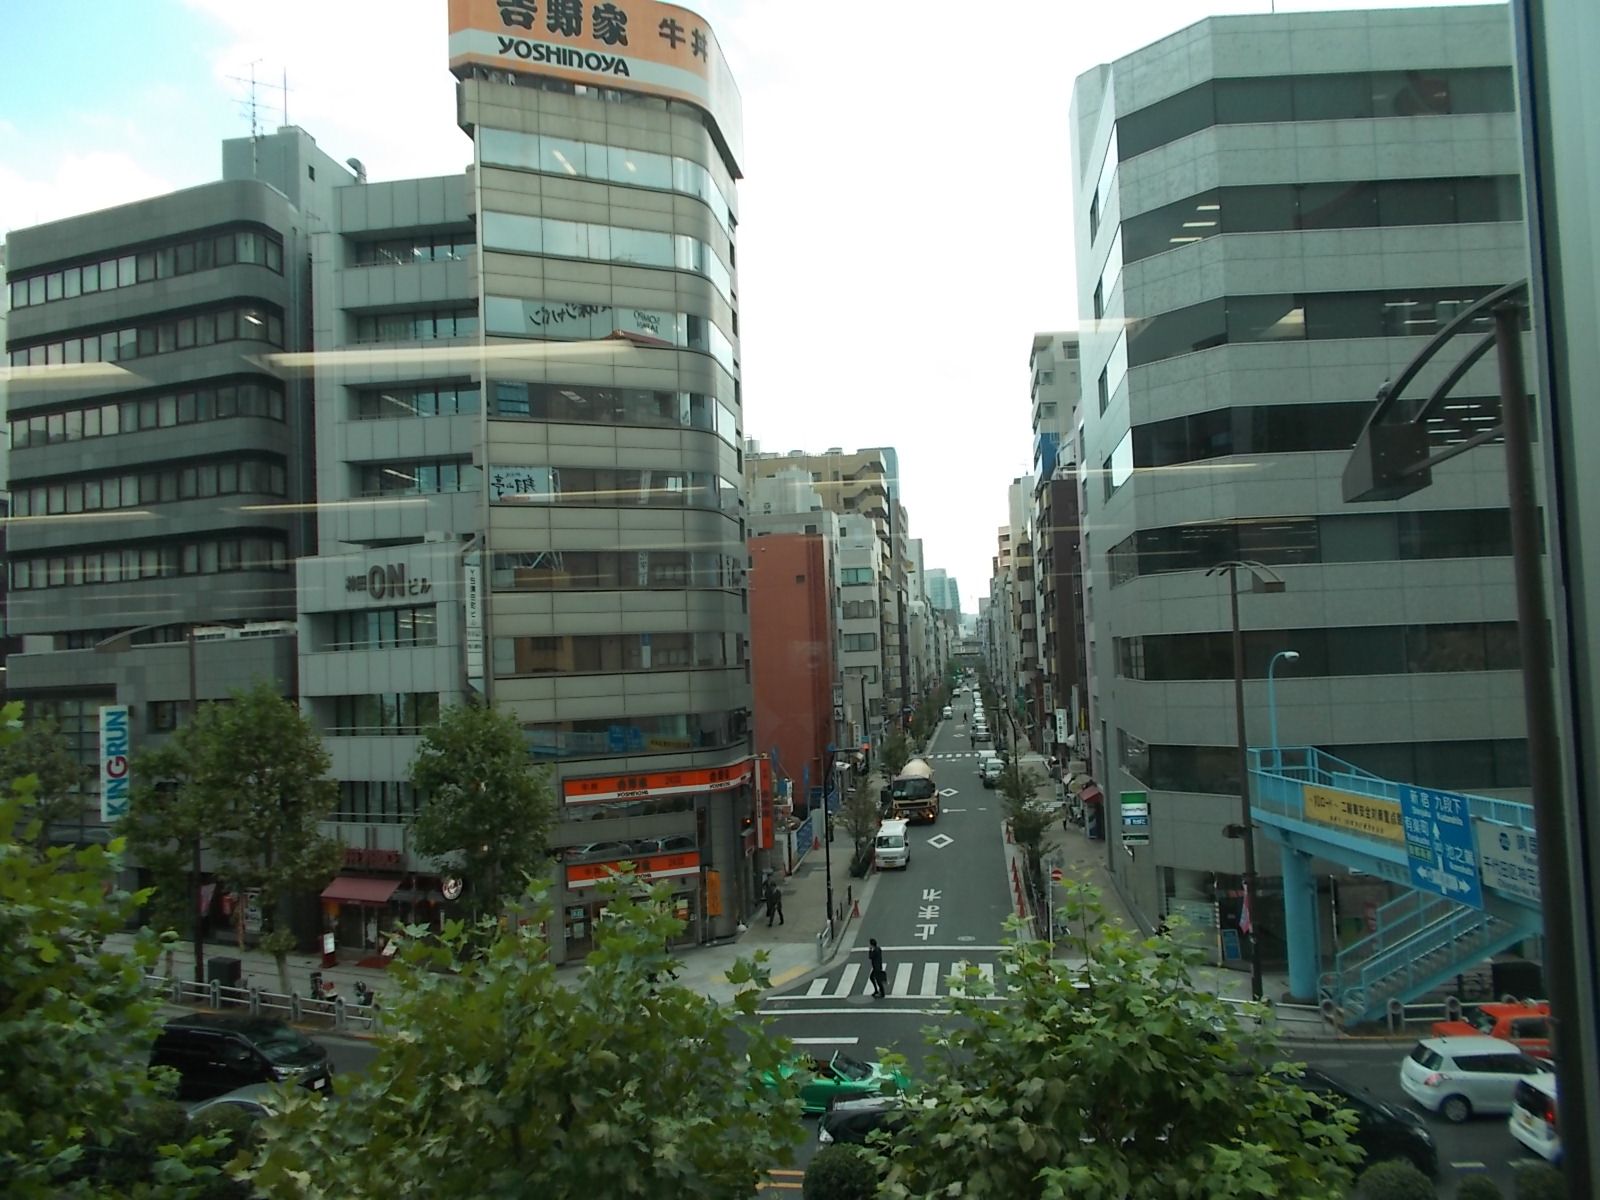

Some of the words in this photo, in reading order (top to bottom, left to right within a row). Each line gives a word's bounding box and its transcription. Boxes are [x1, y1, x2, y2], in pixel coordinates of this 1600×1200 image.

[496, 0, 630, 47] 吉野家
[497, 35, 631, 78] YOSHINOYA
[105, 710, 129, 817] KINGRUN
[914, 888, 943, 941] 止まれ
